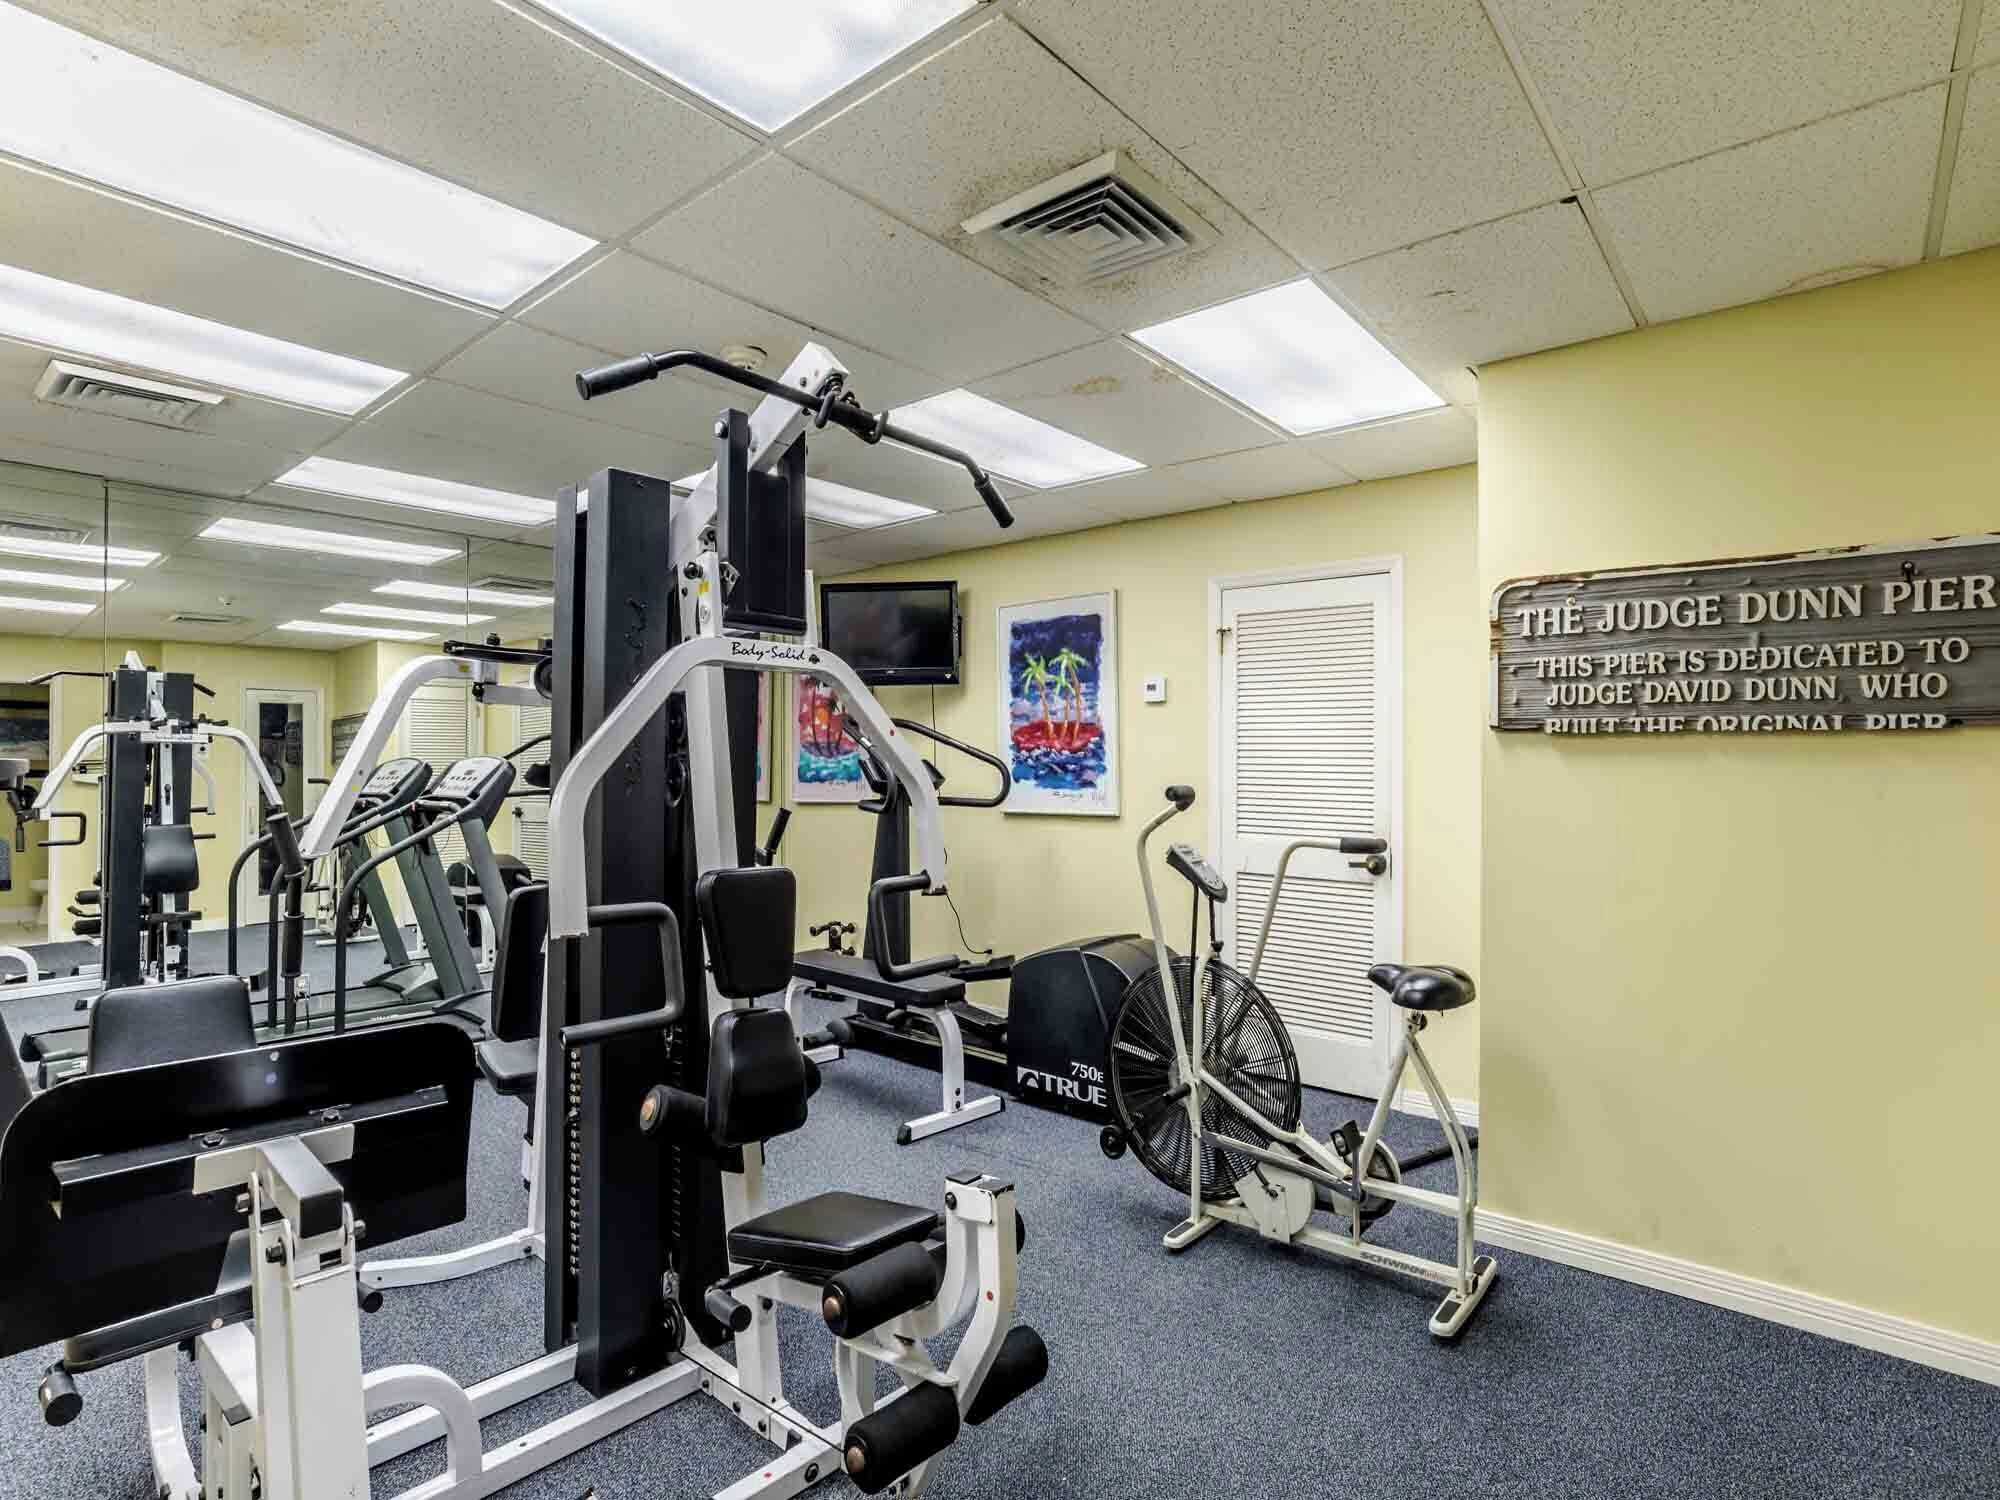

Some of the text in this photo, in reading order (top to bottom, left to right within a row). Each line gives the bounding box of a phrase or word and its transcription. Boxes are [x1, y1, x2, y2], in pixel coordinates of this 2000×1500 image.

[1516, 575, 1998, 637] THE JUDGE DUNN PIER
[731, 641, 806, 661] Body-Solid
[1535, 637, 1969, 679] THIS PIER IS DEDICATED TO
[1546, 682, 1633, 706] JUDGE
[1643, 679, 1733, 704] DAVID
[1858, 672, 1949, 699] WHO
[1039, 1072, 1108, 1108] TRUE
[1071, 1061, 1105, 1084] 750E
